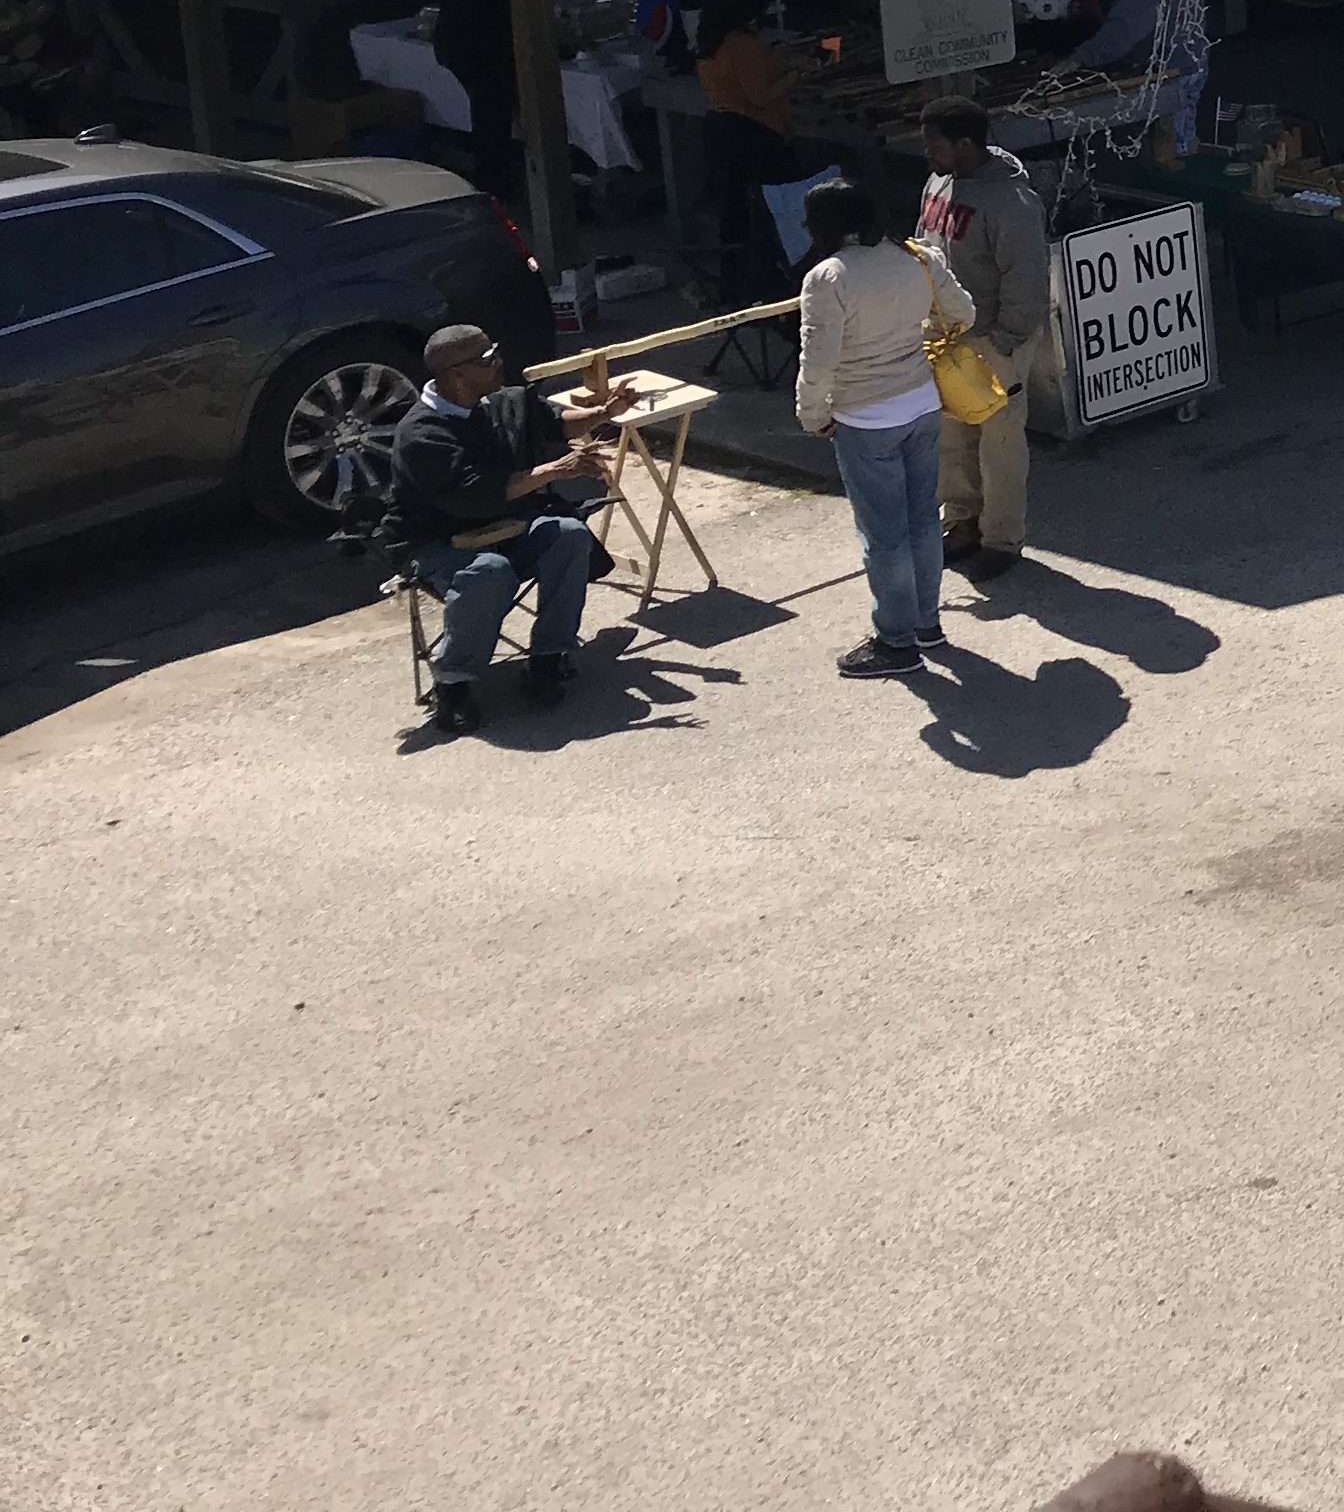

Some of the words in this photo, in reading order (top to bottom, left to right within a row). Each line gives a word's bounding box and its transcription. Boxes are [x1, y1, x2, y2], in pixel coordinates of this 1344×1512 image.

[894, 44, 934, 64] CLEAN
[939, 29, 1008, 56] COMMUNITY
[1075, 251, 1118, 301] DO
[1133, 230, 1190, 284] NOT
[1082, 289, 1197, 361] BLOCK
[1087, 341, 1202, 403] INTERSECTION
